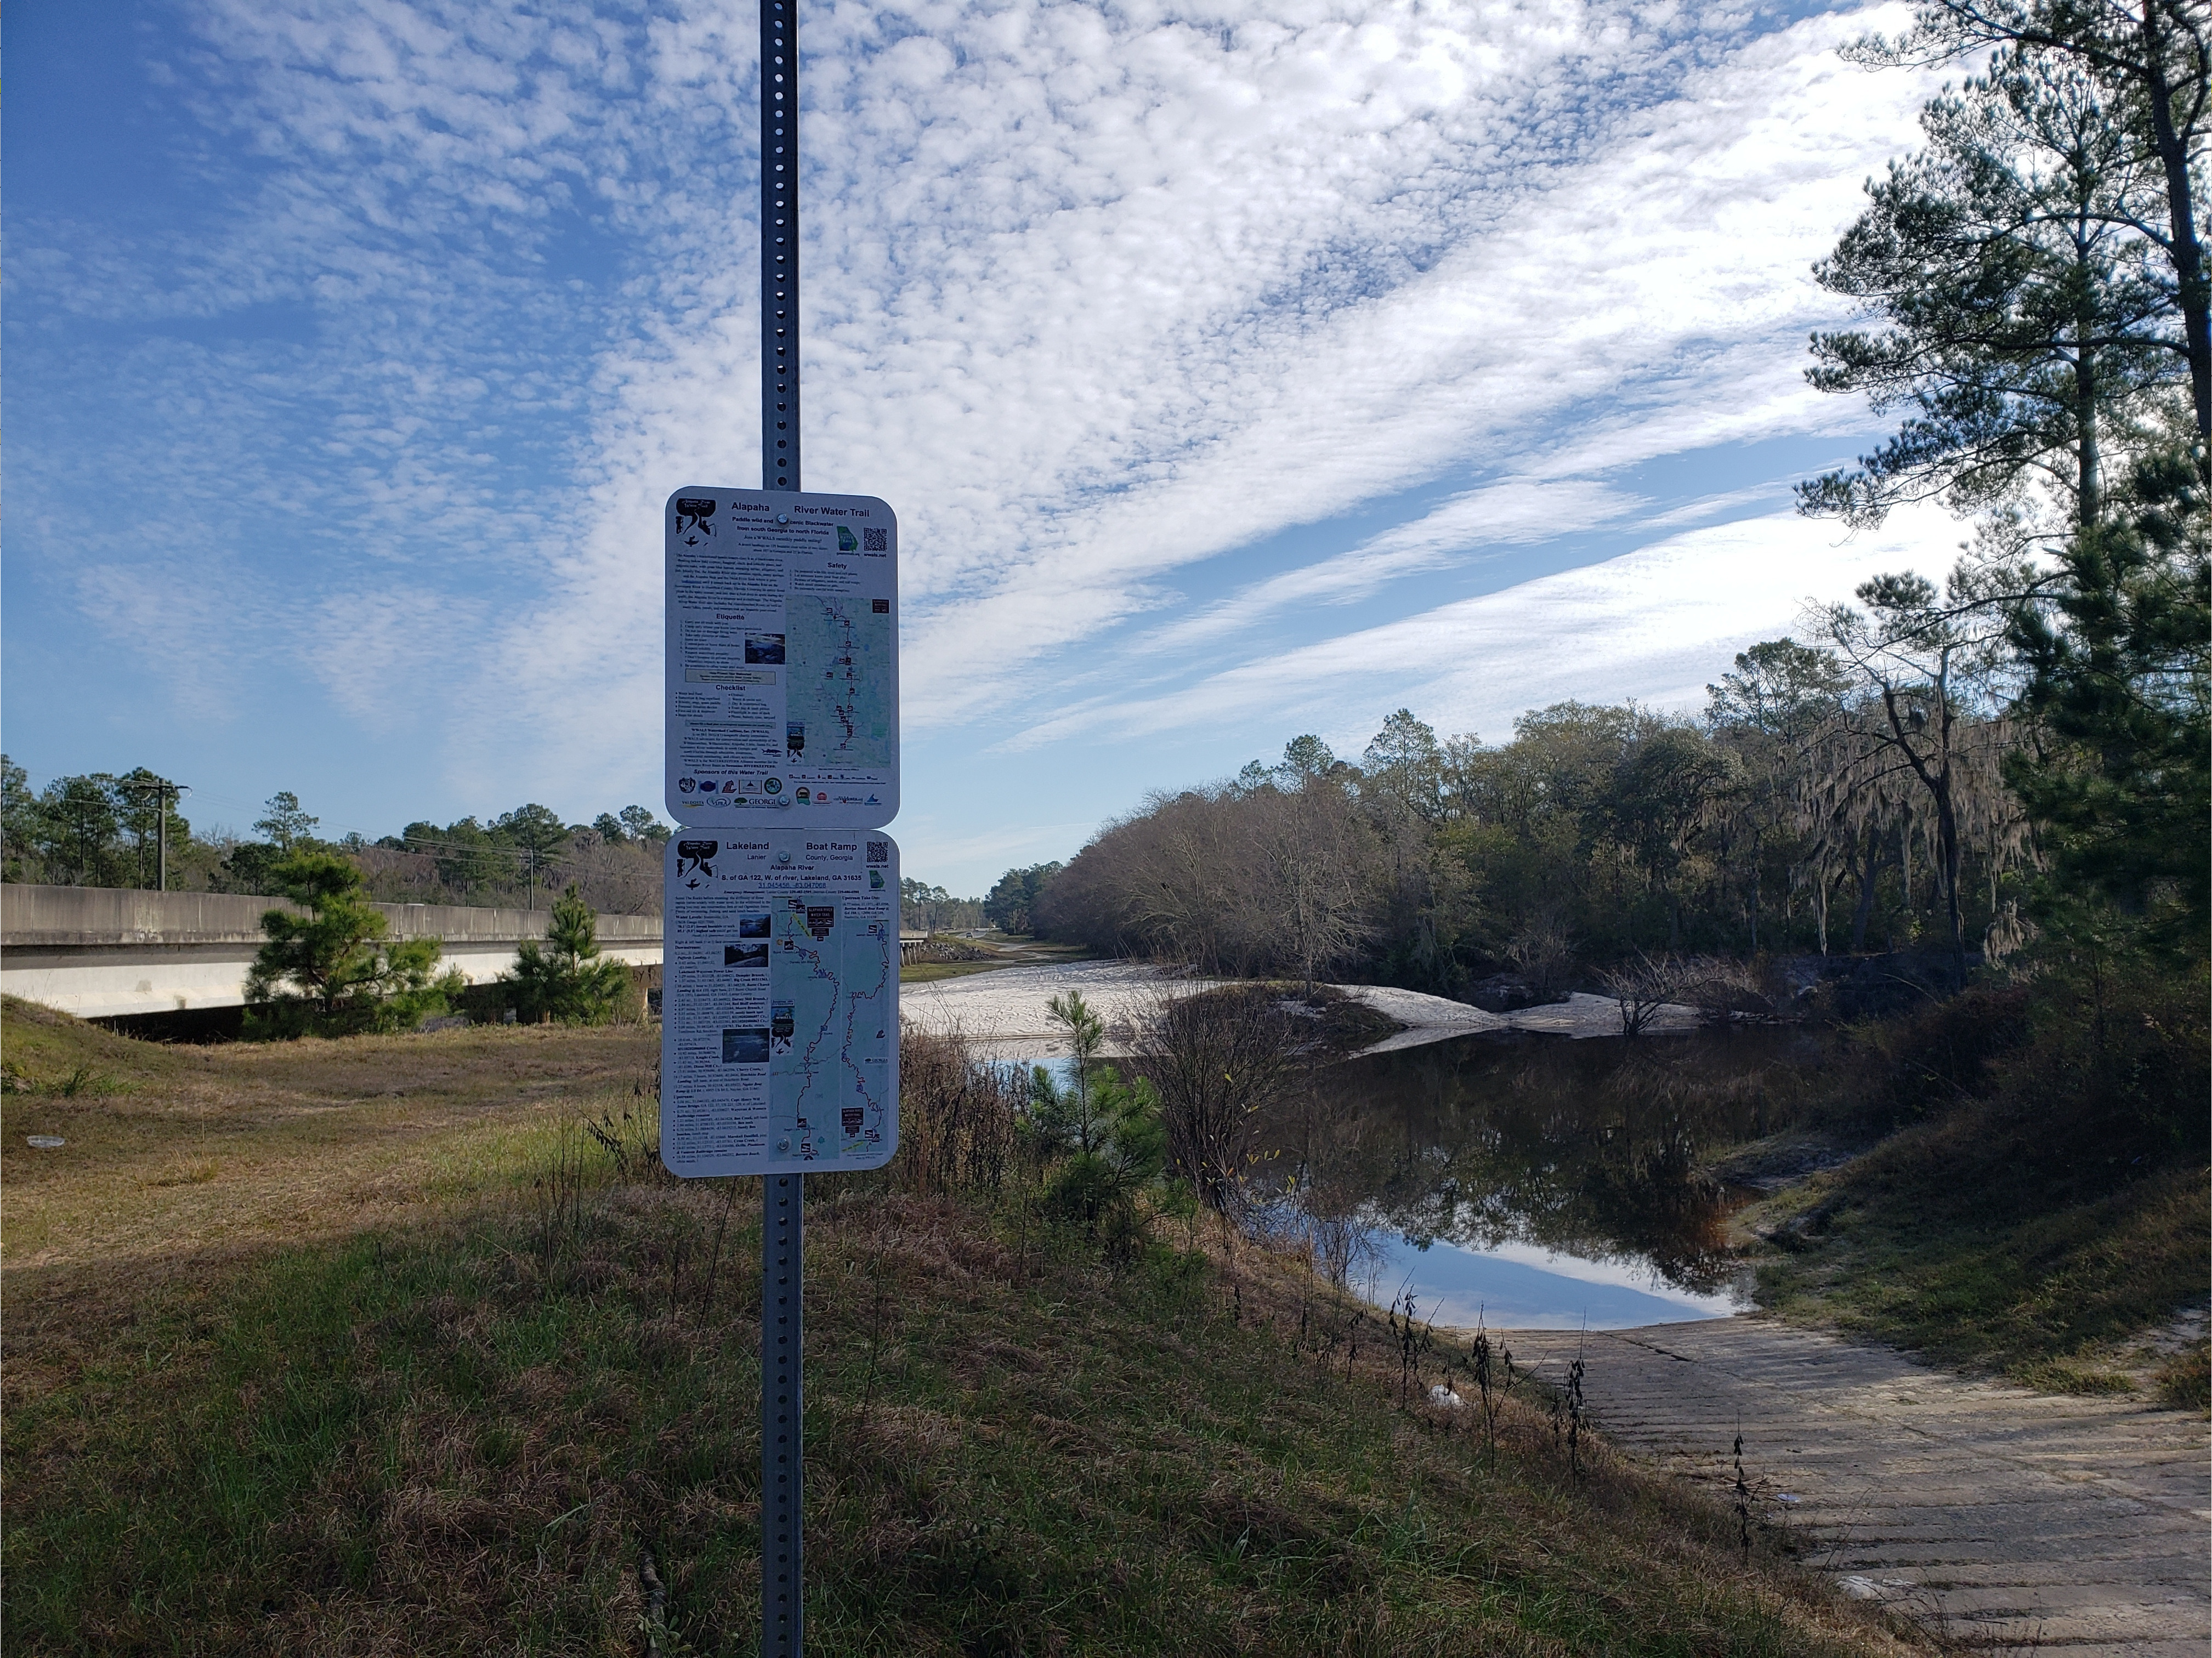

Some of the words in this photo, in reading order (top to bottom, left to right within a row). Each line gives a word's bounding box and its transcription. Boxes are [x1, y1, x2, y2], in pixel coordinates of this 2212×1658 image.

[731, 502, 769, 512] Alapaha
[794, 506, 819, 514] River
[821, 507, 847, 515] Water
[850, 509, 870, 517] Trail
[831, 843, 857, 852] Ramp
